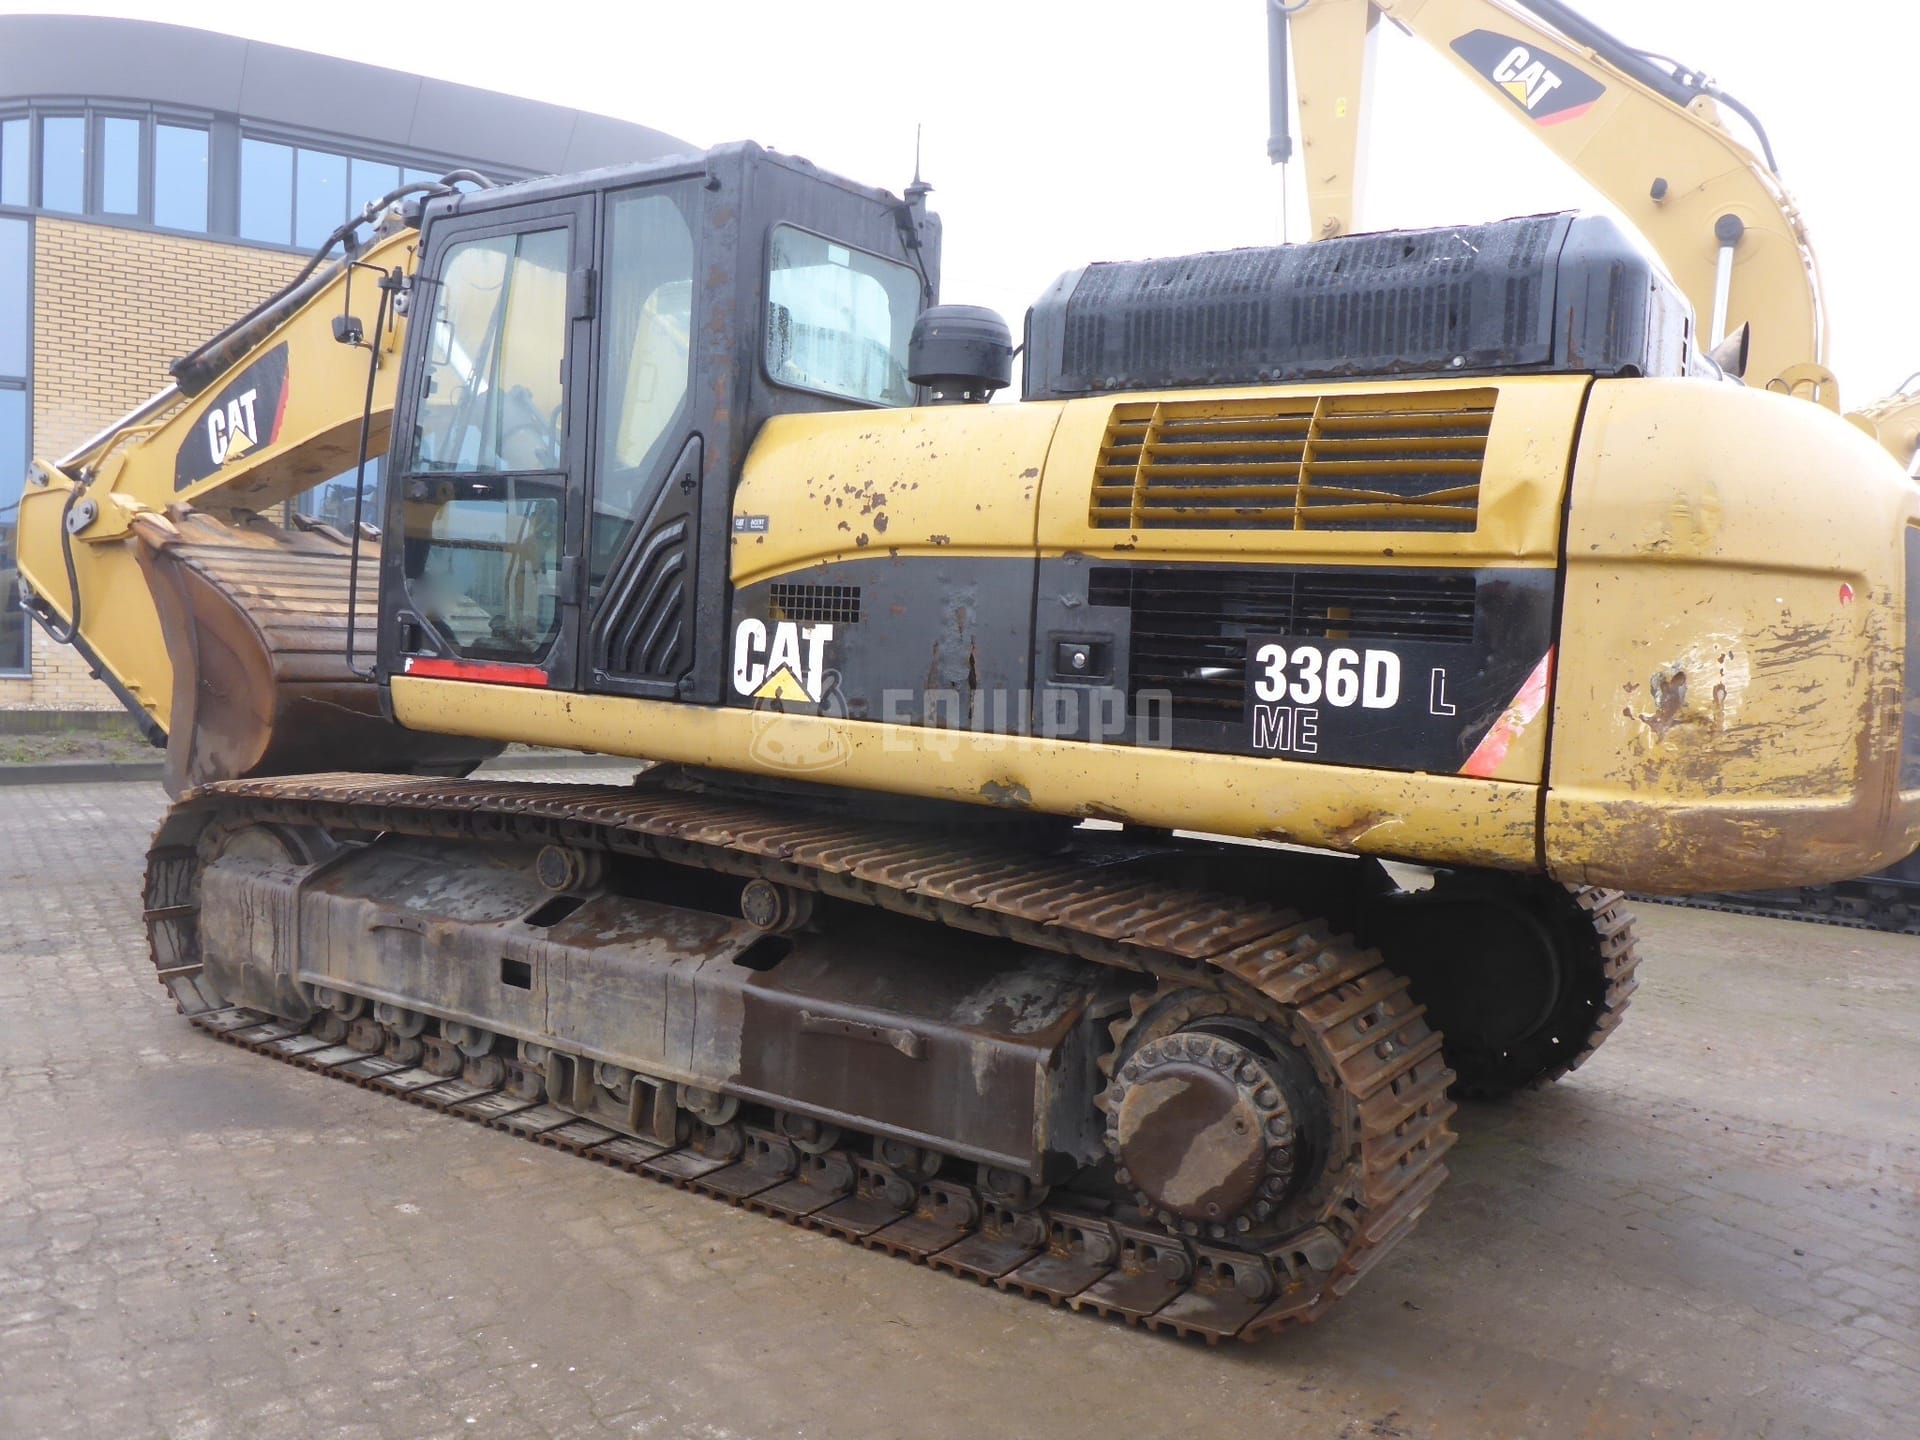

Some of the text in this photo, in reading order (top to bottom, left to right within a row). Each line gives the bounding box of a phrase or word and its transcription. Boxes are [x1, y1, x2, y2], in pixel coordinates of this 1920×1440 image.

[1493, 46, 1562, 110] CAT
[208, 388, 258, 465] CAT
[733, 618, 833, 703] CAT
[1254, 643, 1456, 716] 336D L
[1253, 704, 1319, 754] ME
